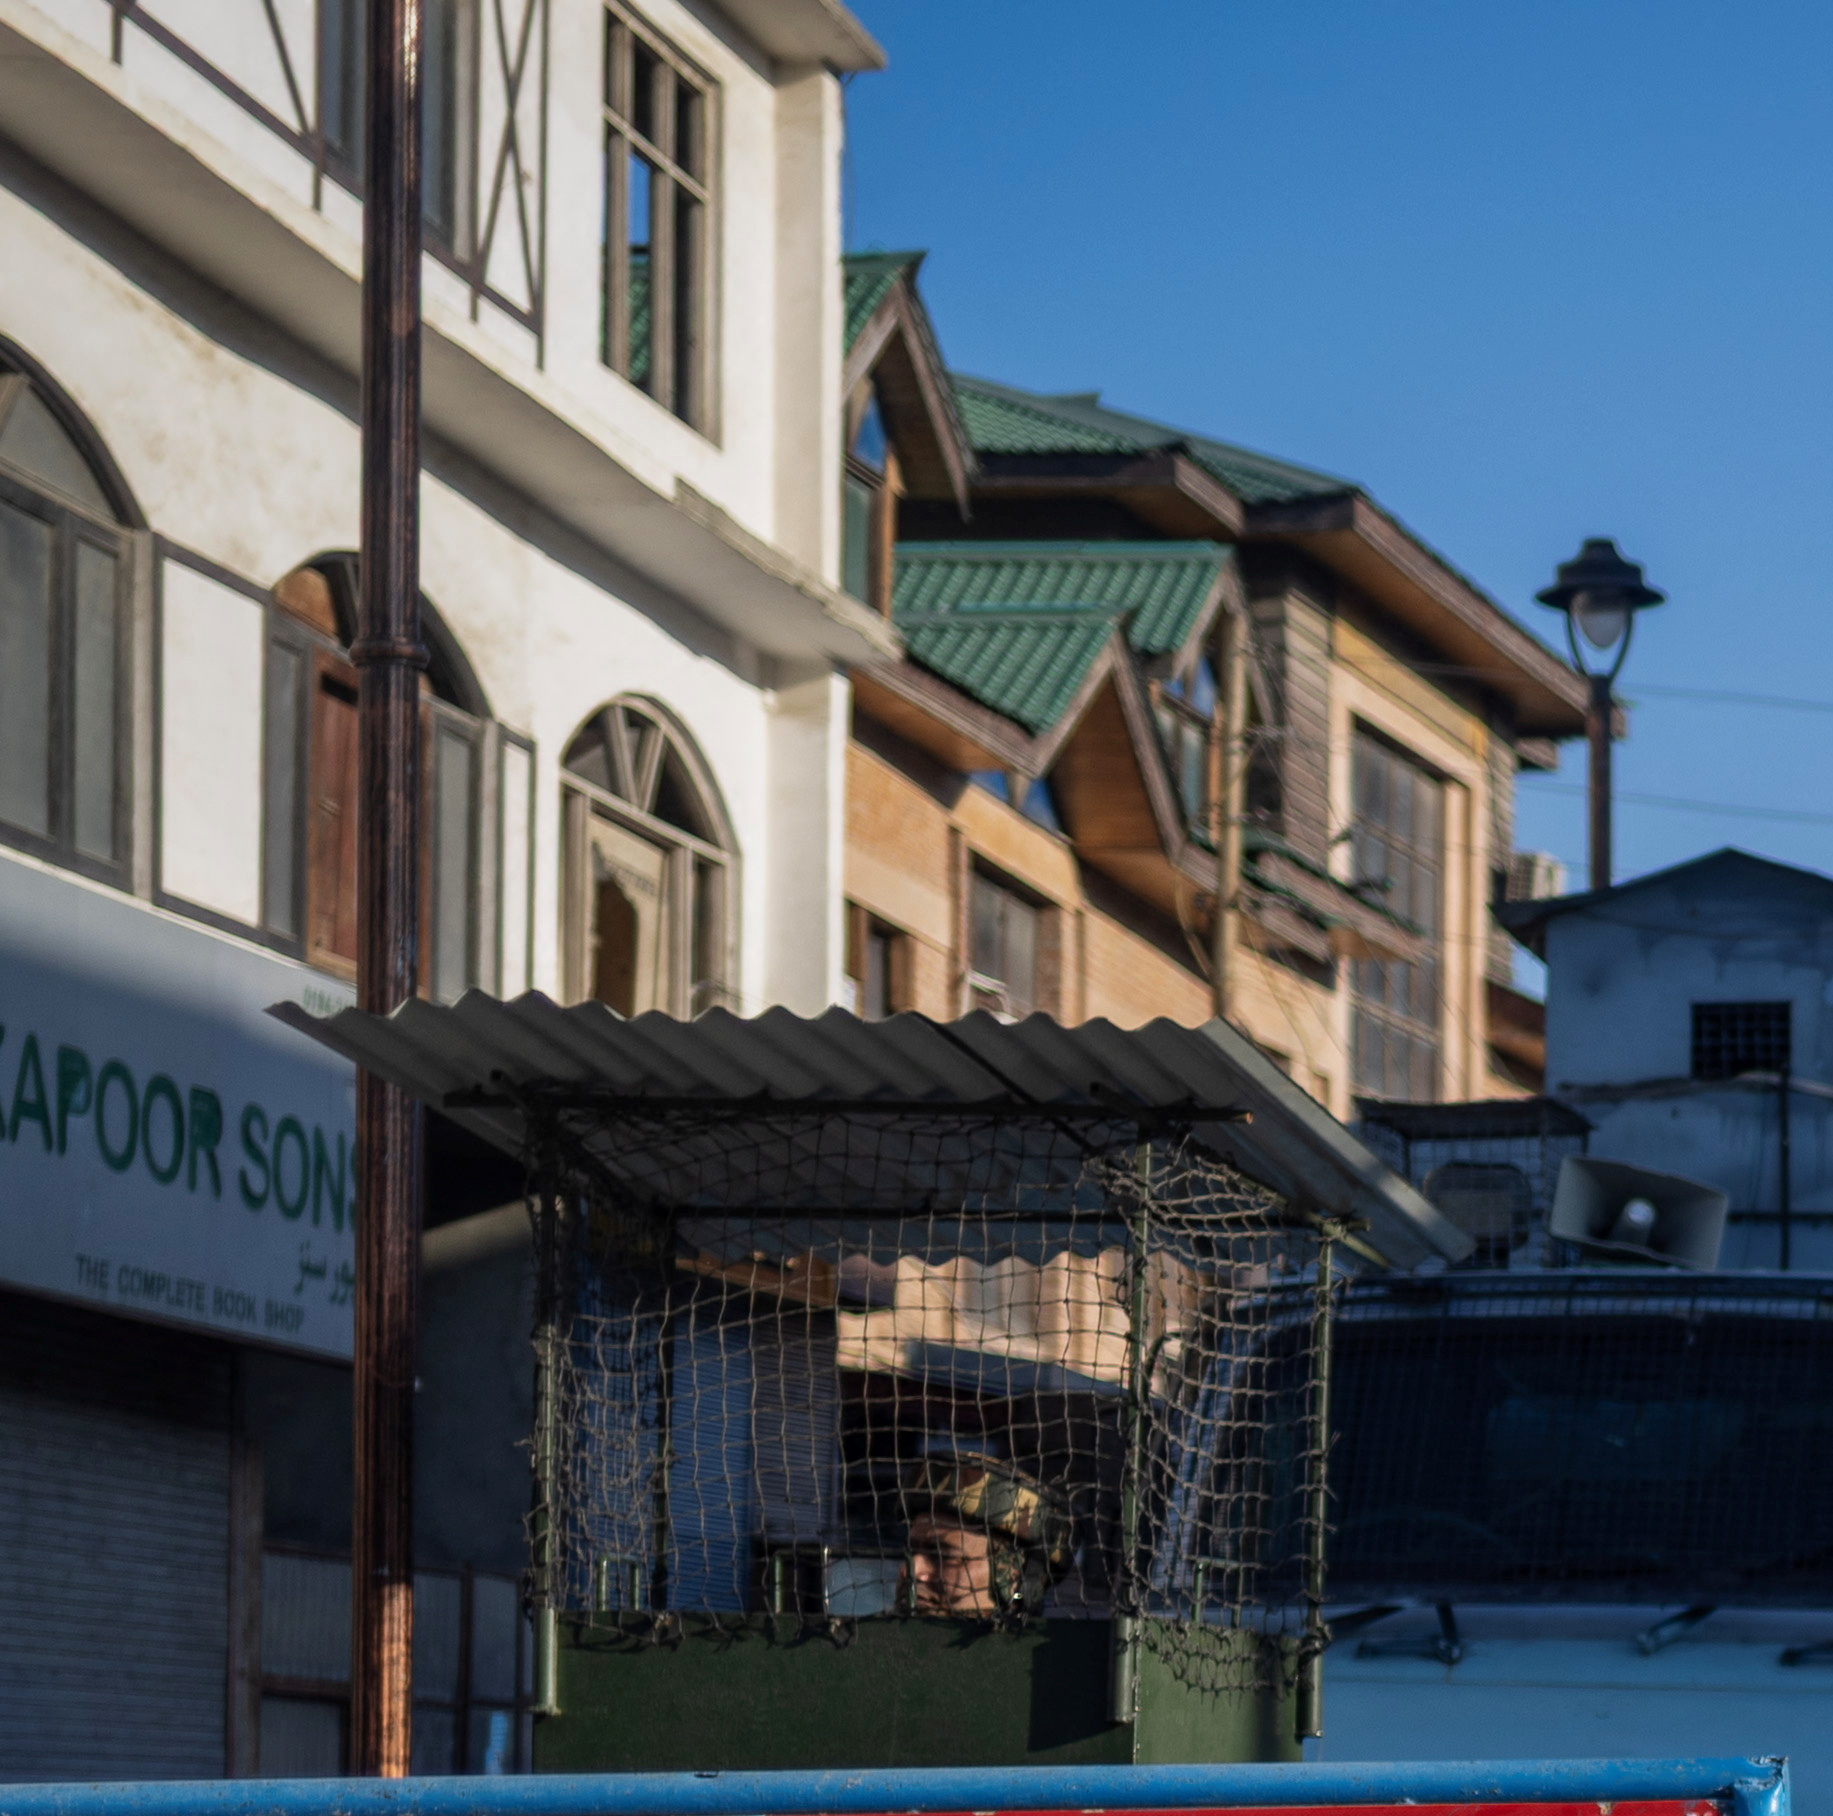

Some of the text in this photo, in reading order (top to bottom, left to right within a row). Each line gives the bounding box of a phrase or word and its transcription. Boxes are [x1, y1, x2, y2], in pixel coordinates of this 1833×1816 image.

[0, 1021, 355, 1235] APOOR SON
[75, 1253, 304, 1333] THE COMPLETE BOOK SHOP
